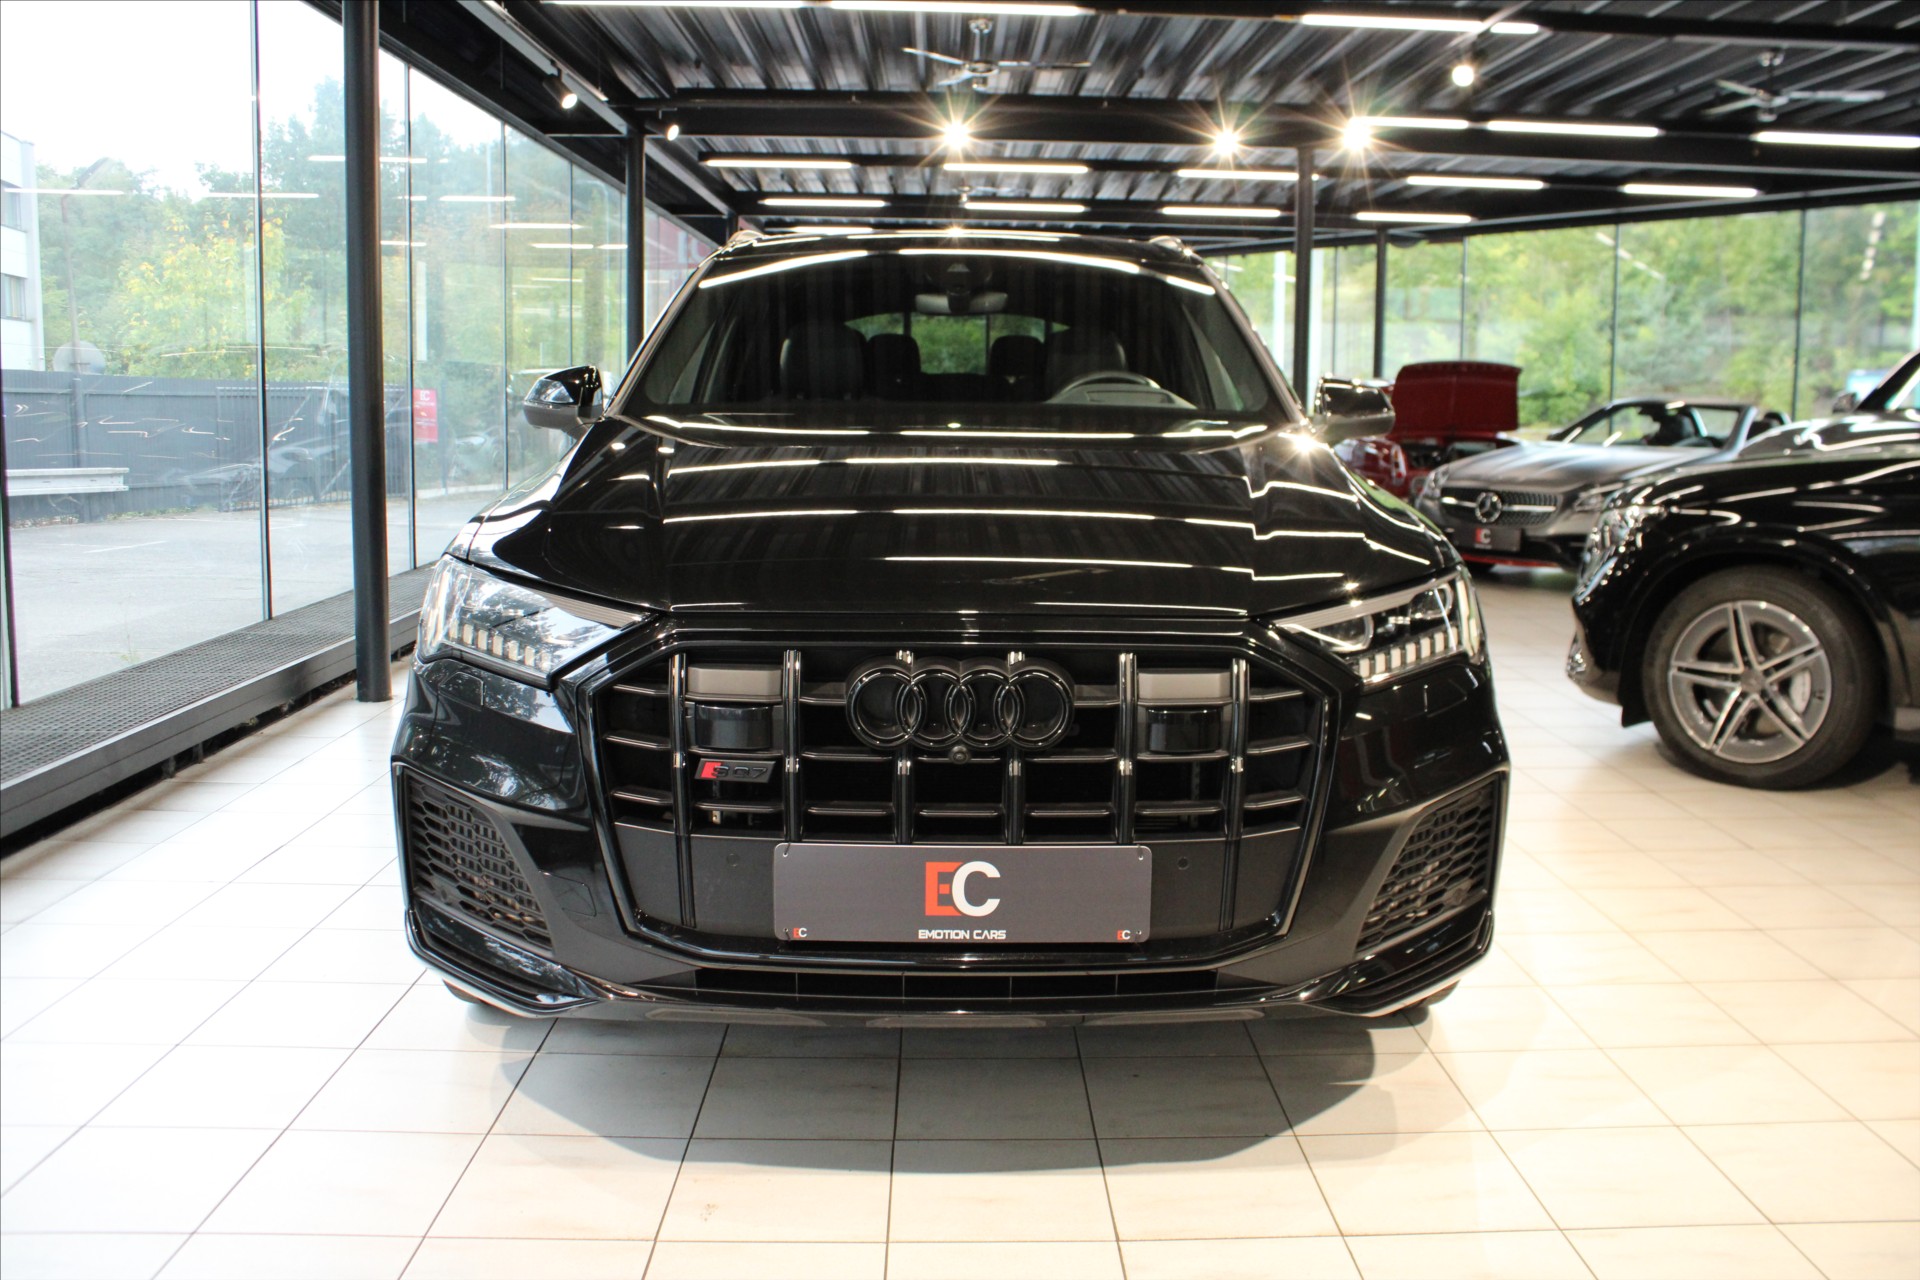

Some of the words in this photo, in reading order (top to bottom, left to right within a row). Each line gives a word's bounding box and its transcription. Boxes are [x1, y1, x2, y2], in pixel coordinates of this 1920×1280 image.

[711, 765, 769, 779] SQ7
[925, 861, 1001, 917] EC
[793, 927, 807, 938] EC
[918, 929, 970, 940] EMOTION
[973, 929, 1007, 940] CARS
